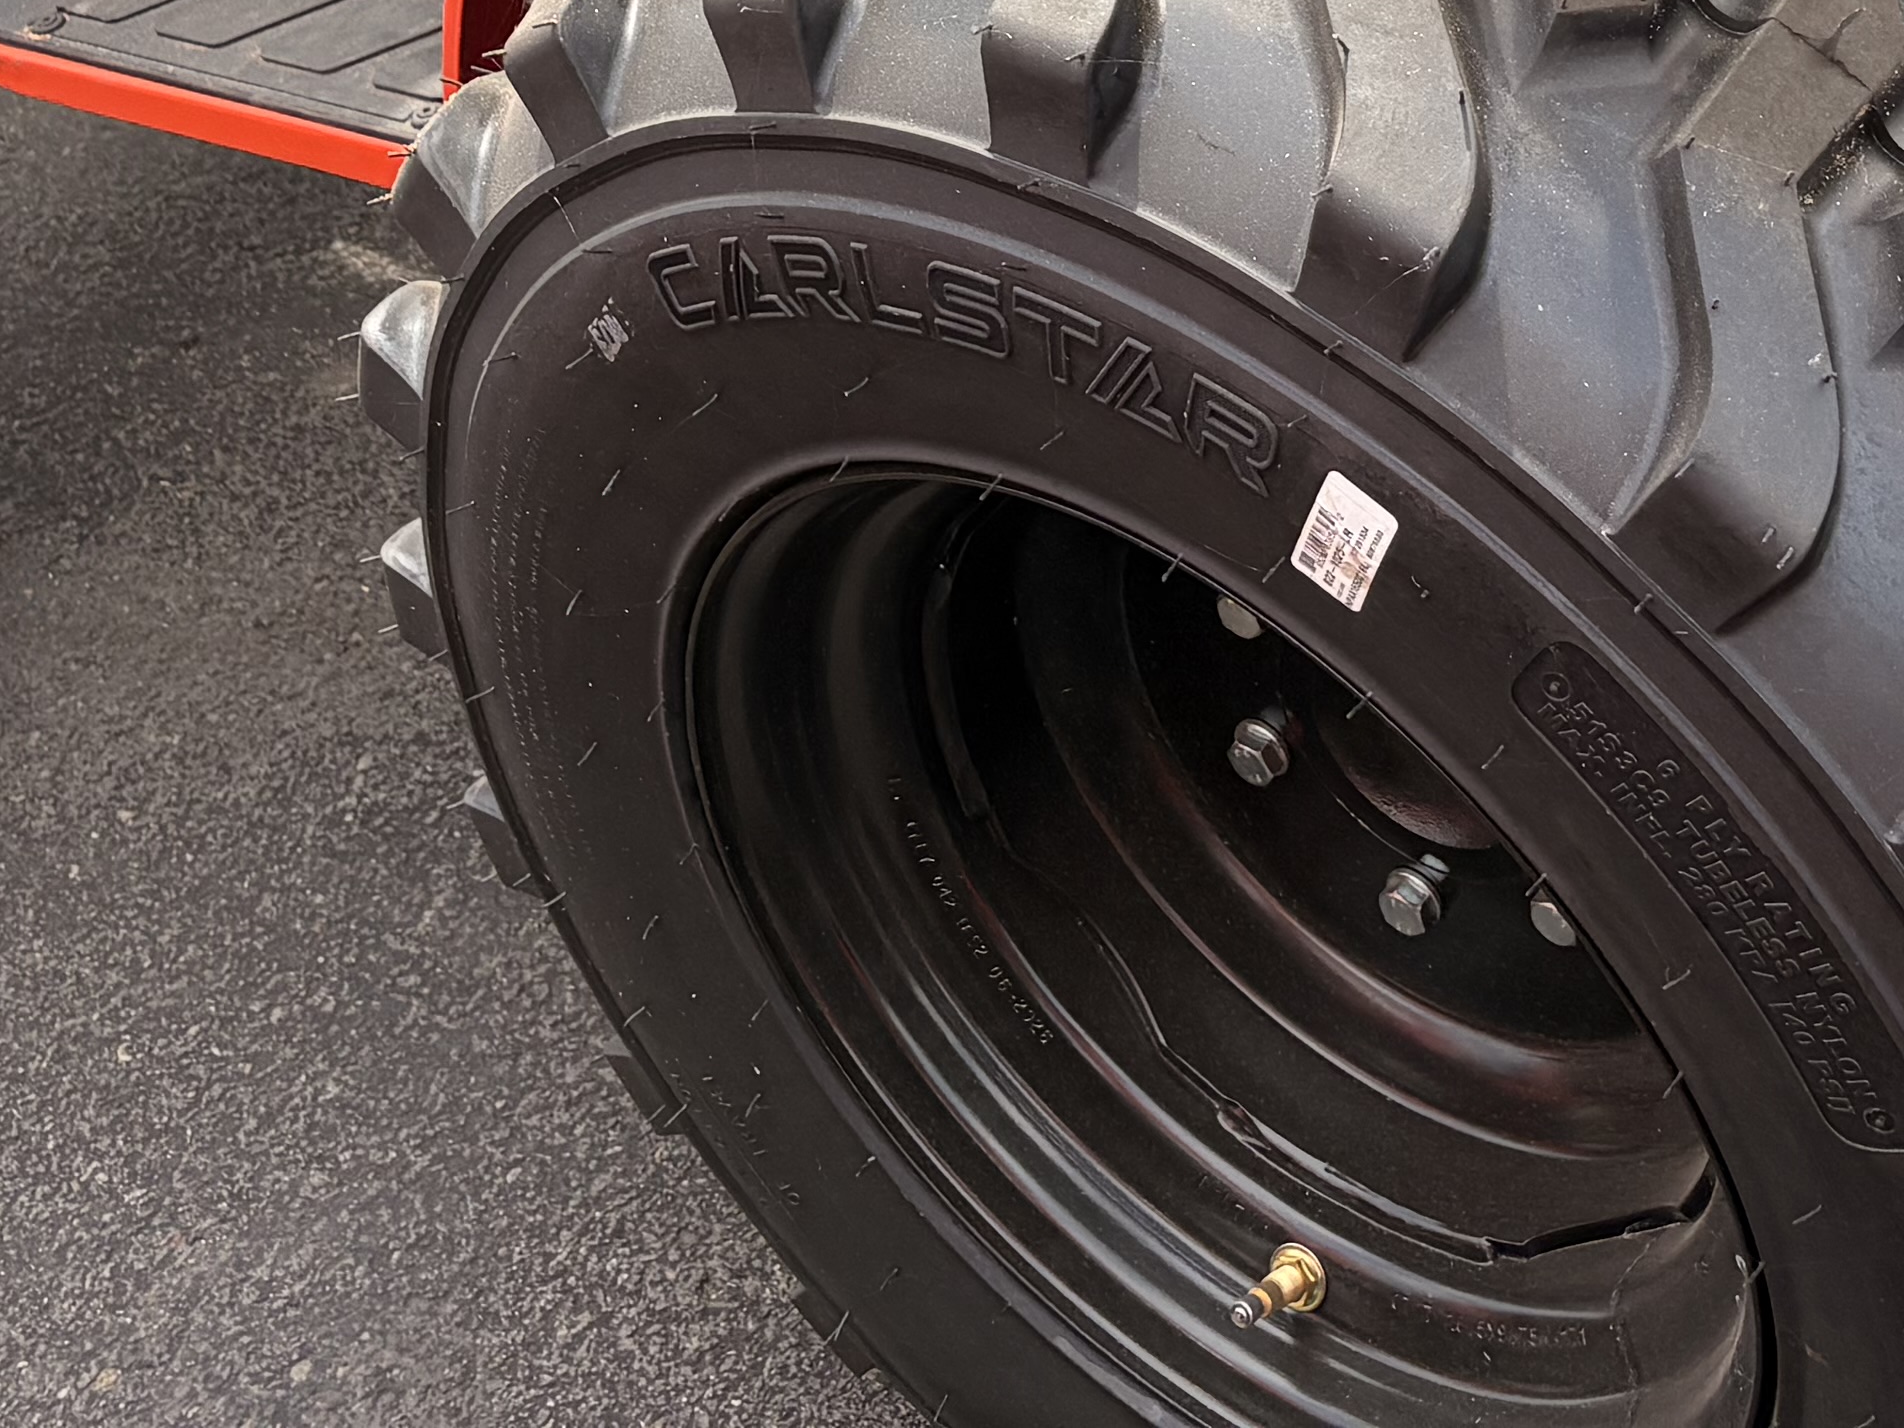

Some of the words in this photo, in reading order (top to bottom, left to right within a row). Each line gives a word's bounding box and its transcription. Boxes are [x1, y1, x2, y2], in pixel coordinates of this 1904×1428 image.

[646, 233, 1284, 496] CARLSTAR
[1675, 819, 1800, 982] TUBELESS
[1794, 990, 1879, 1108] NYLON
[1684, 794, 1753, 859] PLY
[1743, 871, 1858, 1014] RATING
